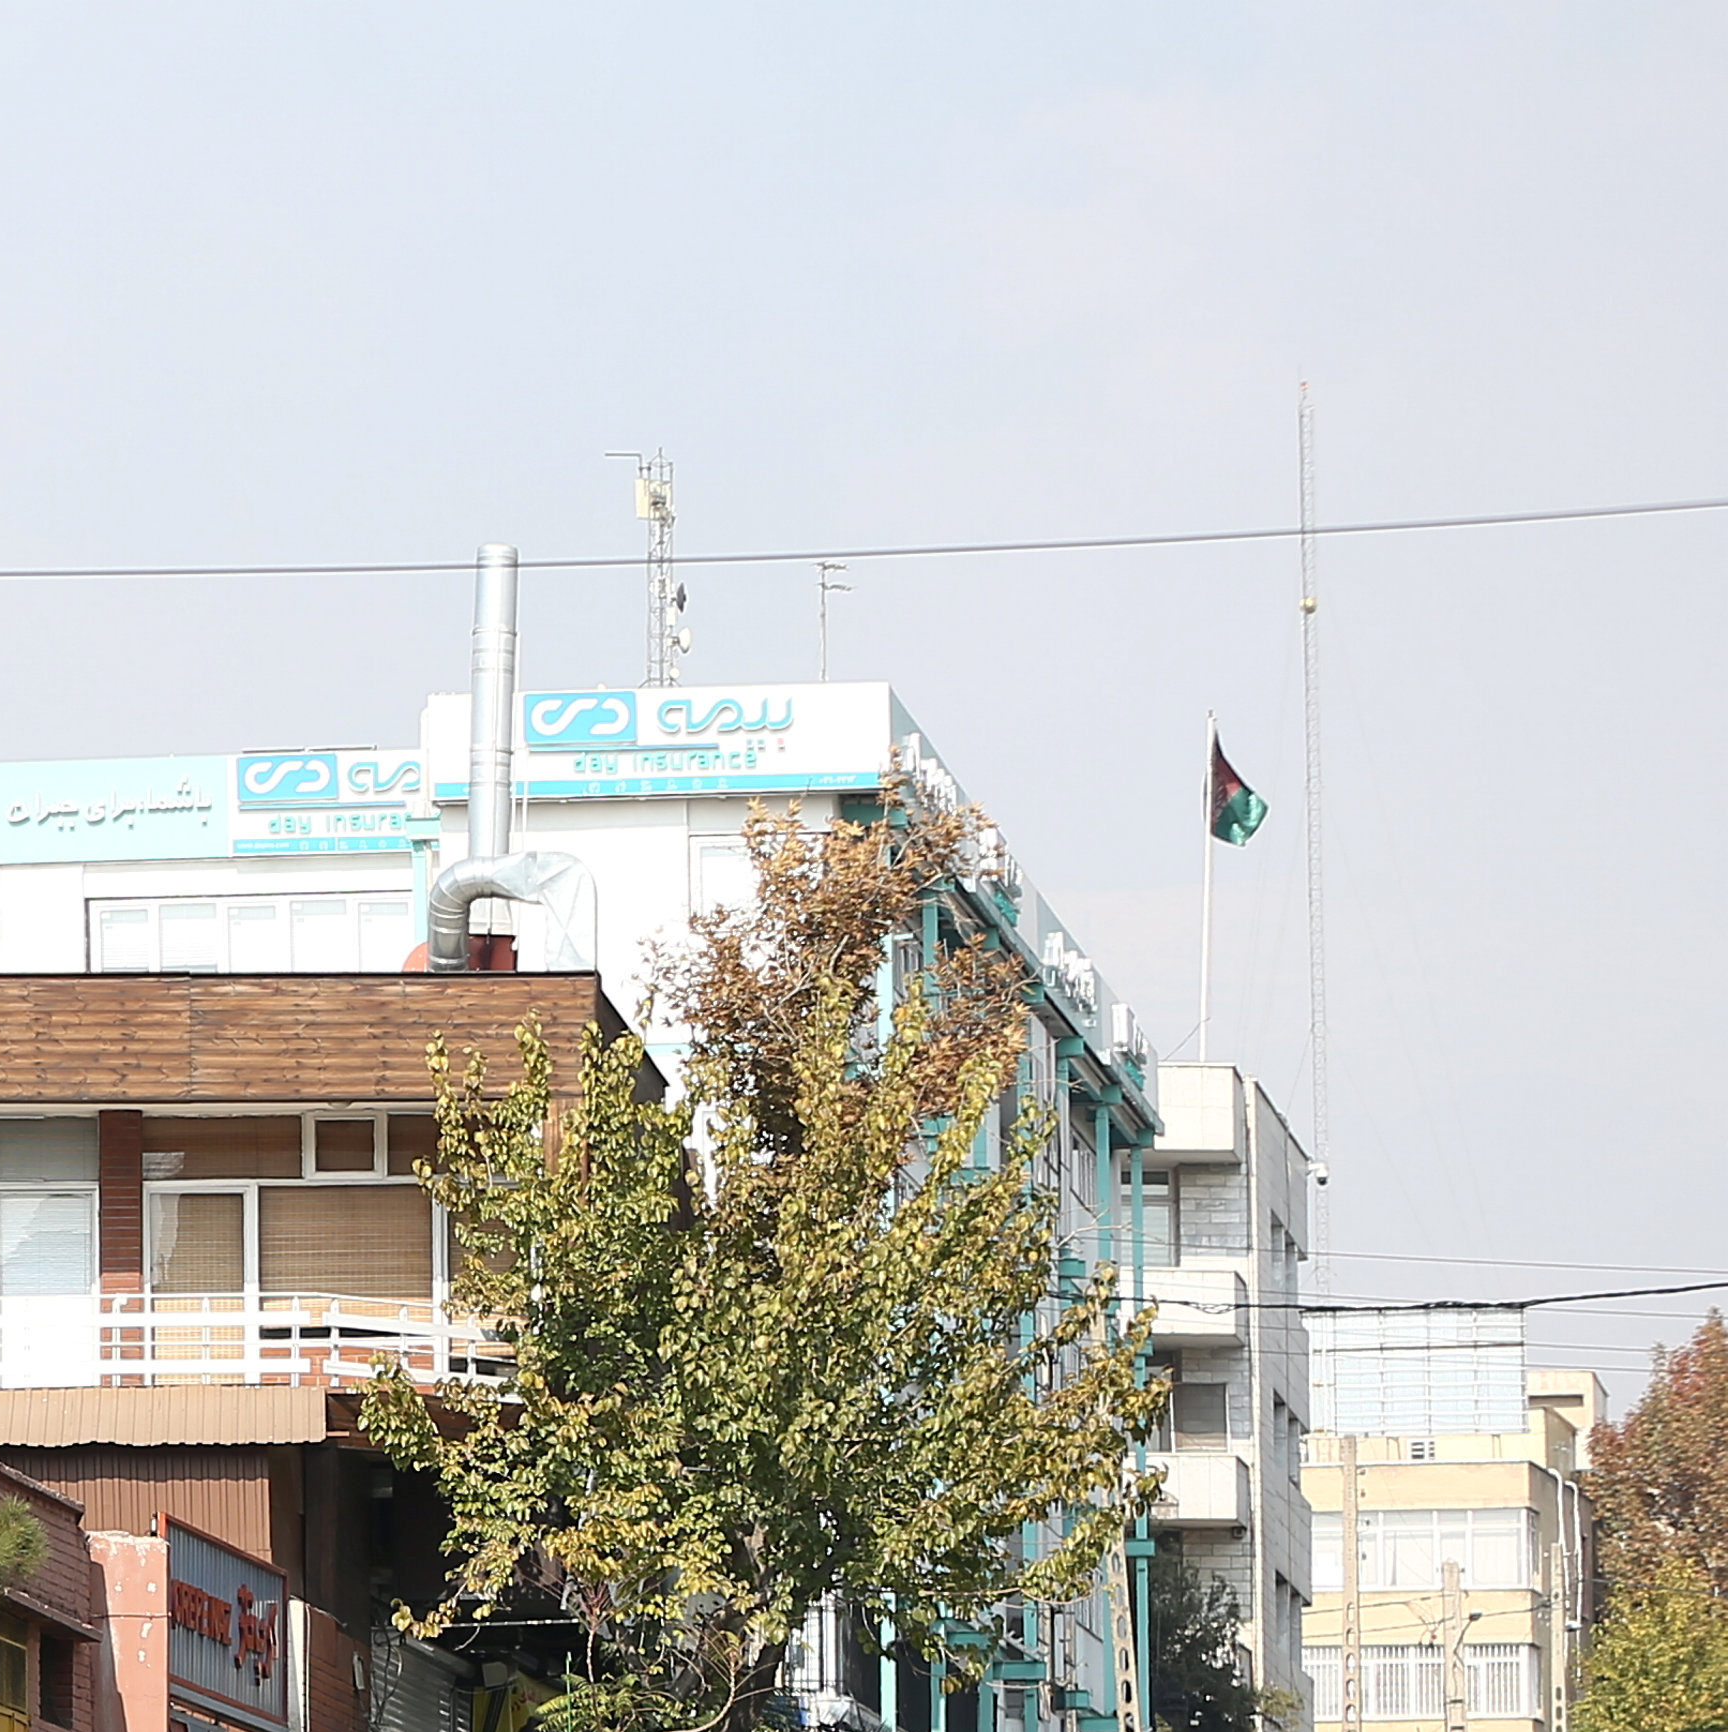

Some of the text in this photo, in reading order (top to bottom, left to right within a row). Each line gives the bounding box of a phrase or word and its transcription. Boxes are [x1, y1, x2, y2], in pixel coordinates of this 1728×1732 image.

[574, 749, 757, 775] day insurance
[269, 814, 313, 834] day
